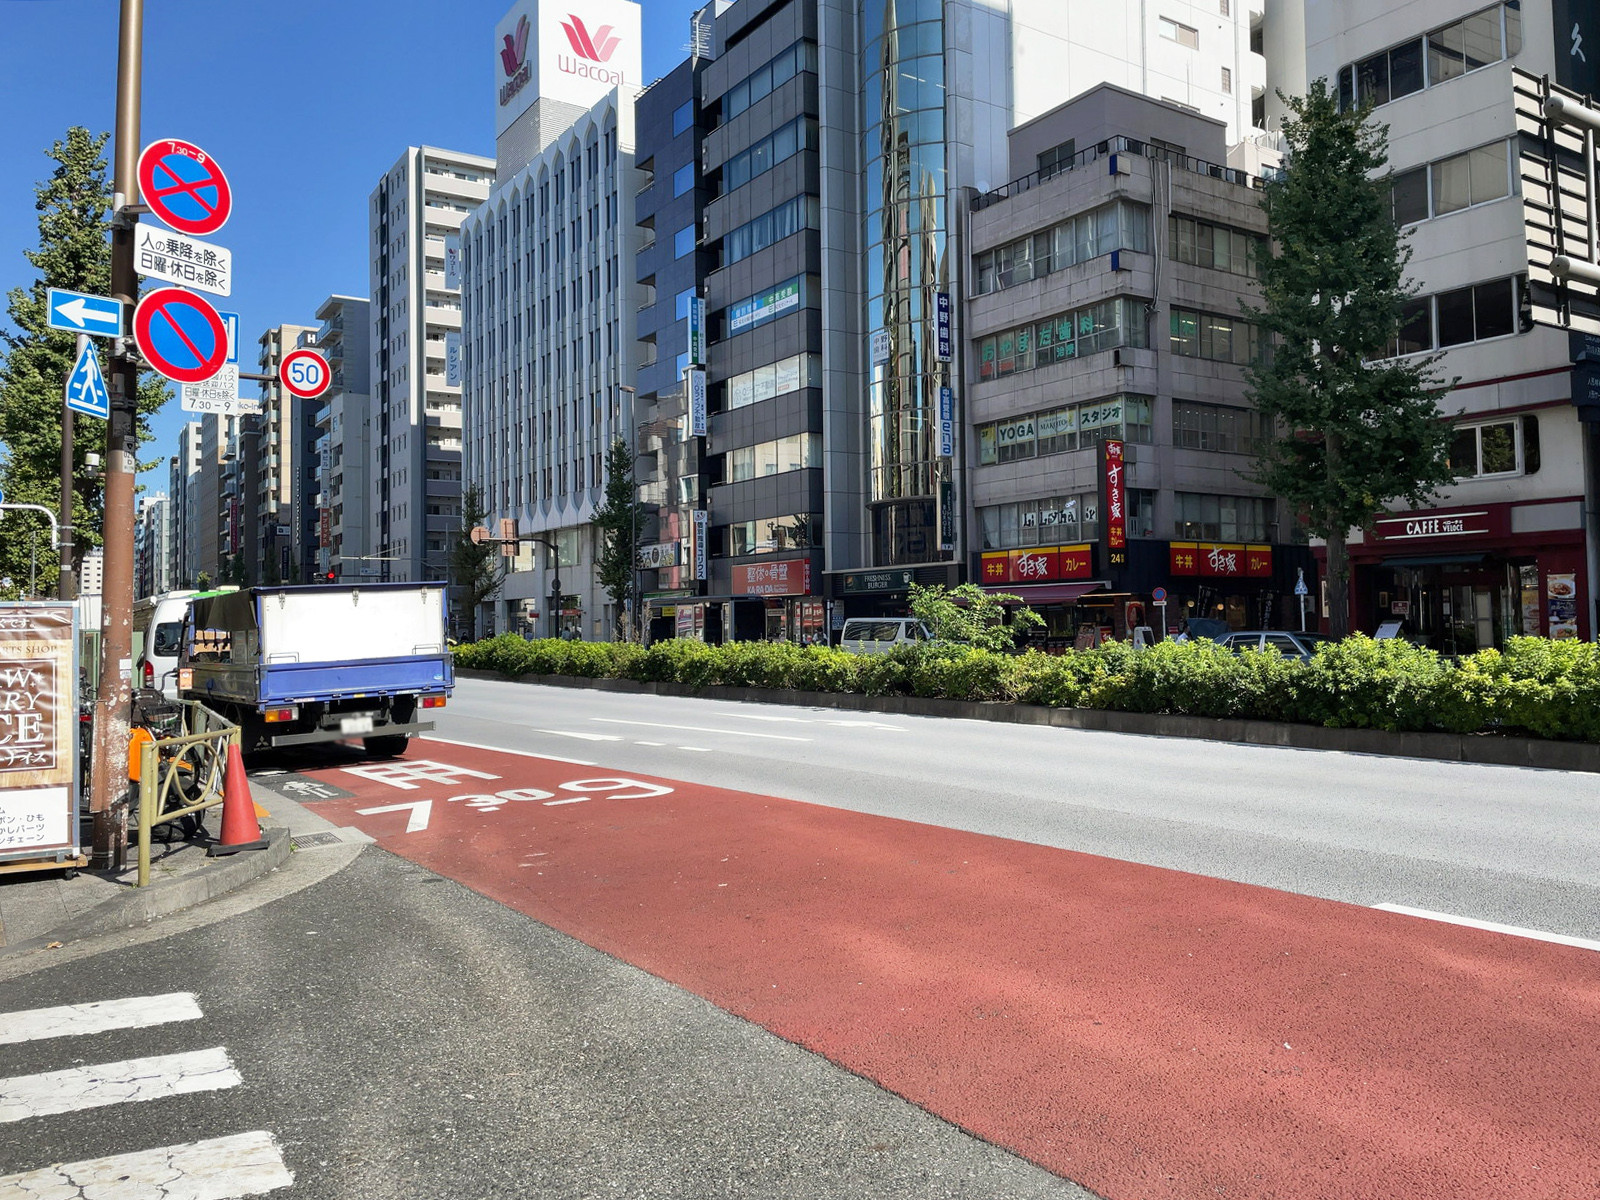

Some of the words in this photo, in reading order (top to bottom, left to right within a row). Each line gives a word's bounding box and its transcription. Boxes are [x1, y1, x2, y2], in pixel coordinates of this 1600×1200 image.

[141, 232, 226, 270] 人の乗降を除く
[939, 297, 949, 354] 中野歯科
[292, 362, 319, 385] 50
[1082, 405, 1122, 425] スタジオ
[1000, 423, 1034, 441] YOGA
[1108, 463, 1122, 521] すき家
[986, 562, 1003, 576] 牛丼
[1017, 550, 1048, 579] すき家
[1065, 558, 1086, 572] カレー
[1175, 554, 1193, 568] 牛丼
[1207, 544, 1236, 575] すき家
[0, 668, 33, 688] W
[0, 691, 42, 711] RY
